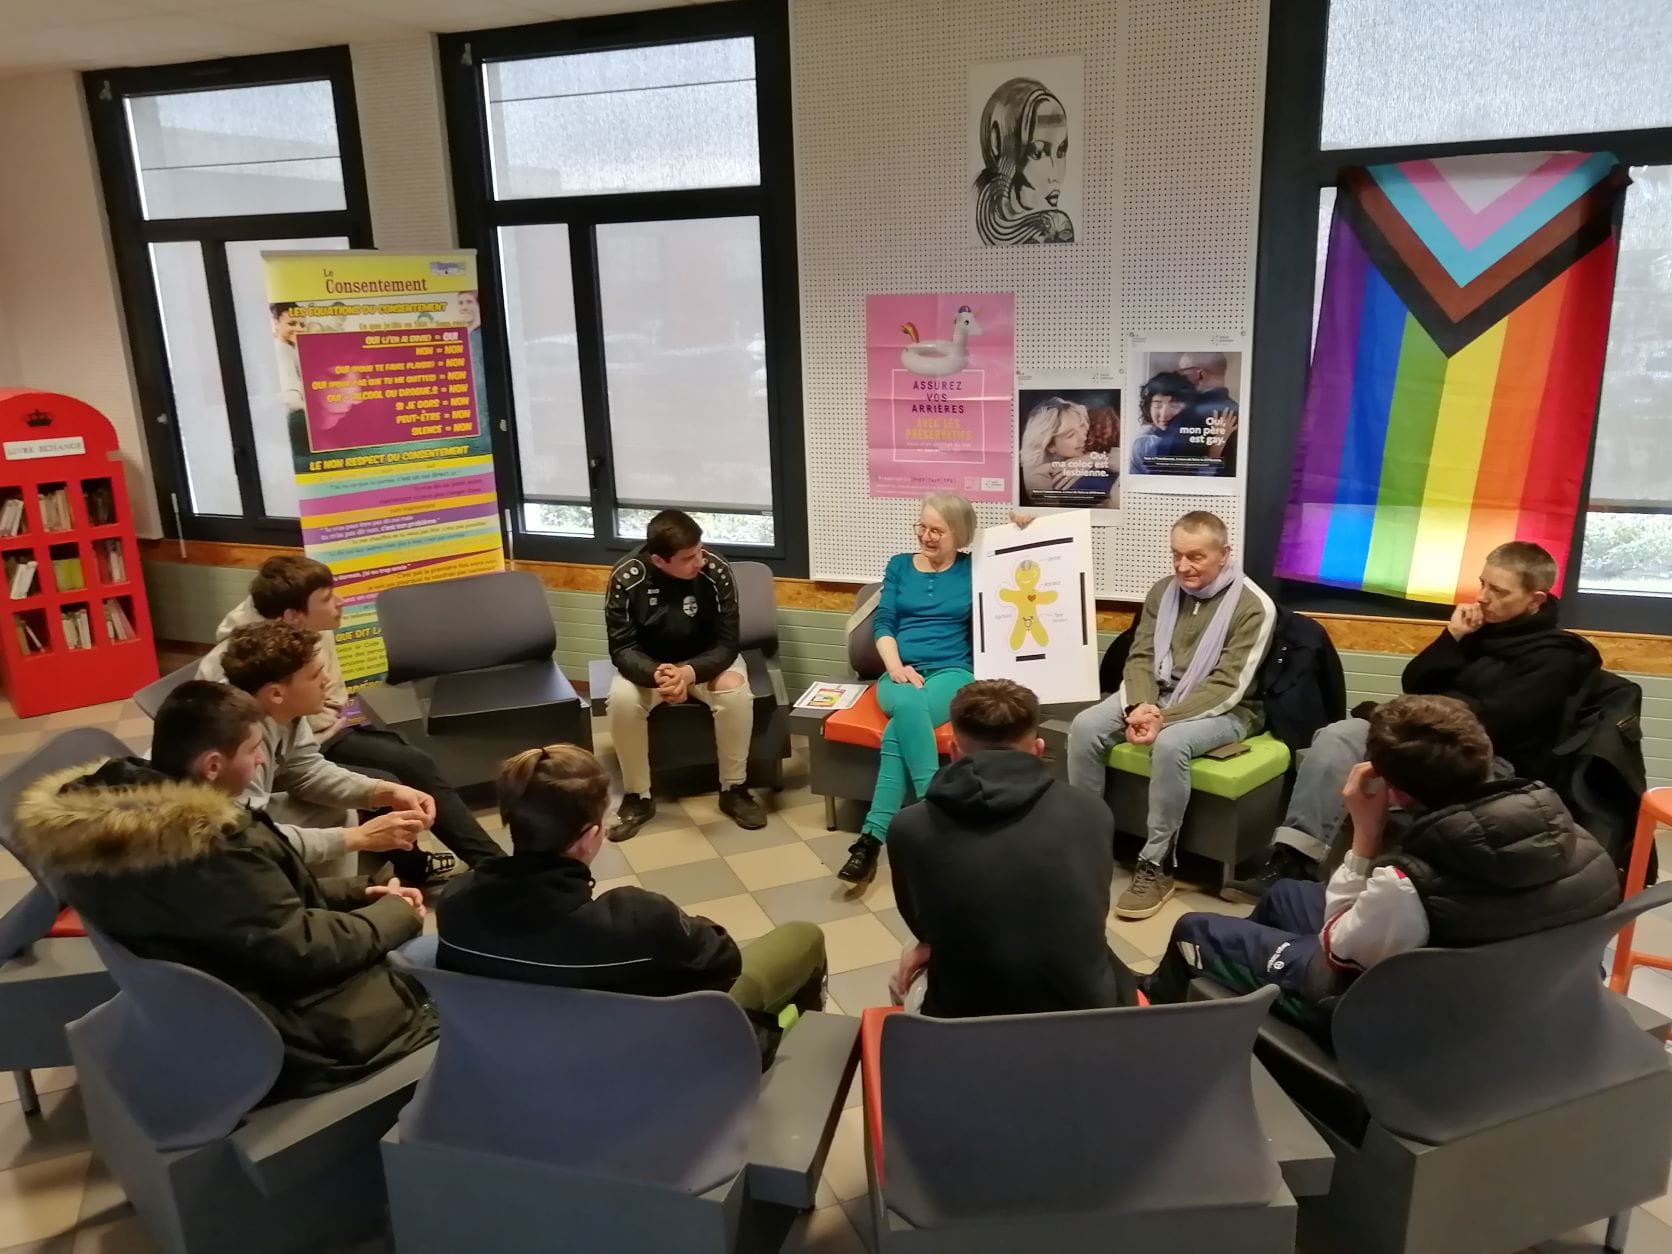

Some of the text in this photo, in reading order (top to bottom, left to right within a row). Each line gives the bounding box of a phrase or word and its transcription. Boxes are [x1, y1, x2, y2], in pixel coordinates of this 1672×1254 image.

[323, 268, 334, 277] Le
[325, 278, 428, 294] Consentement
[288, 306, 305, 317] LES
[378, 302, 448, 315] CONSENTEMENT
[444, 344, 464, 354] NON
[445, 357, 465, 367] NON
[447, 370, 467, 381] NON
[448, 383, 469, 394] NON
[913, 380, 962, 391] ASSUREZ
[450, 396, 470, 407] NON
[926, 393, 948, 403] VOS
[451, 409, 472, 419] NON
[911, 404, 965, 414] ARRIERES
[411, 425, 442, 436] SILENCE
[453, 422, 473, 433] NON
[1179, 425, 1226, 437] mon père
[1189, 435, 1226, 446] est gay.
[309, 460, 323, 471] LE
[323, 458, 345, 469] NON
[345, 454, 386, 467] RESPECT
[386, 453, 401, 463] DU
[401, 445, 470, 461] CONSENTEMENT
[1067, 459, 1093, 468] coloc
[1063, 467, 1109, 477] lesbienne.
[336, 631, 353, 642] QUE
[355, 627, 370, 639] DIT
